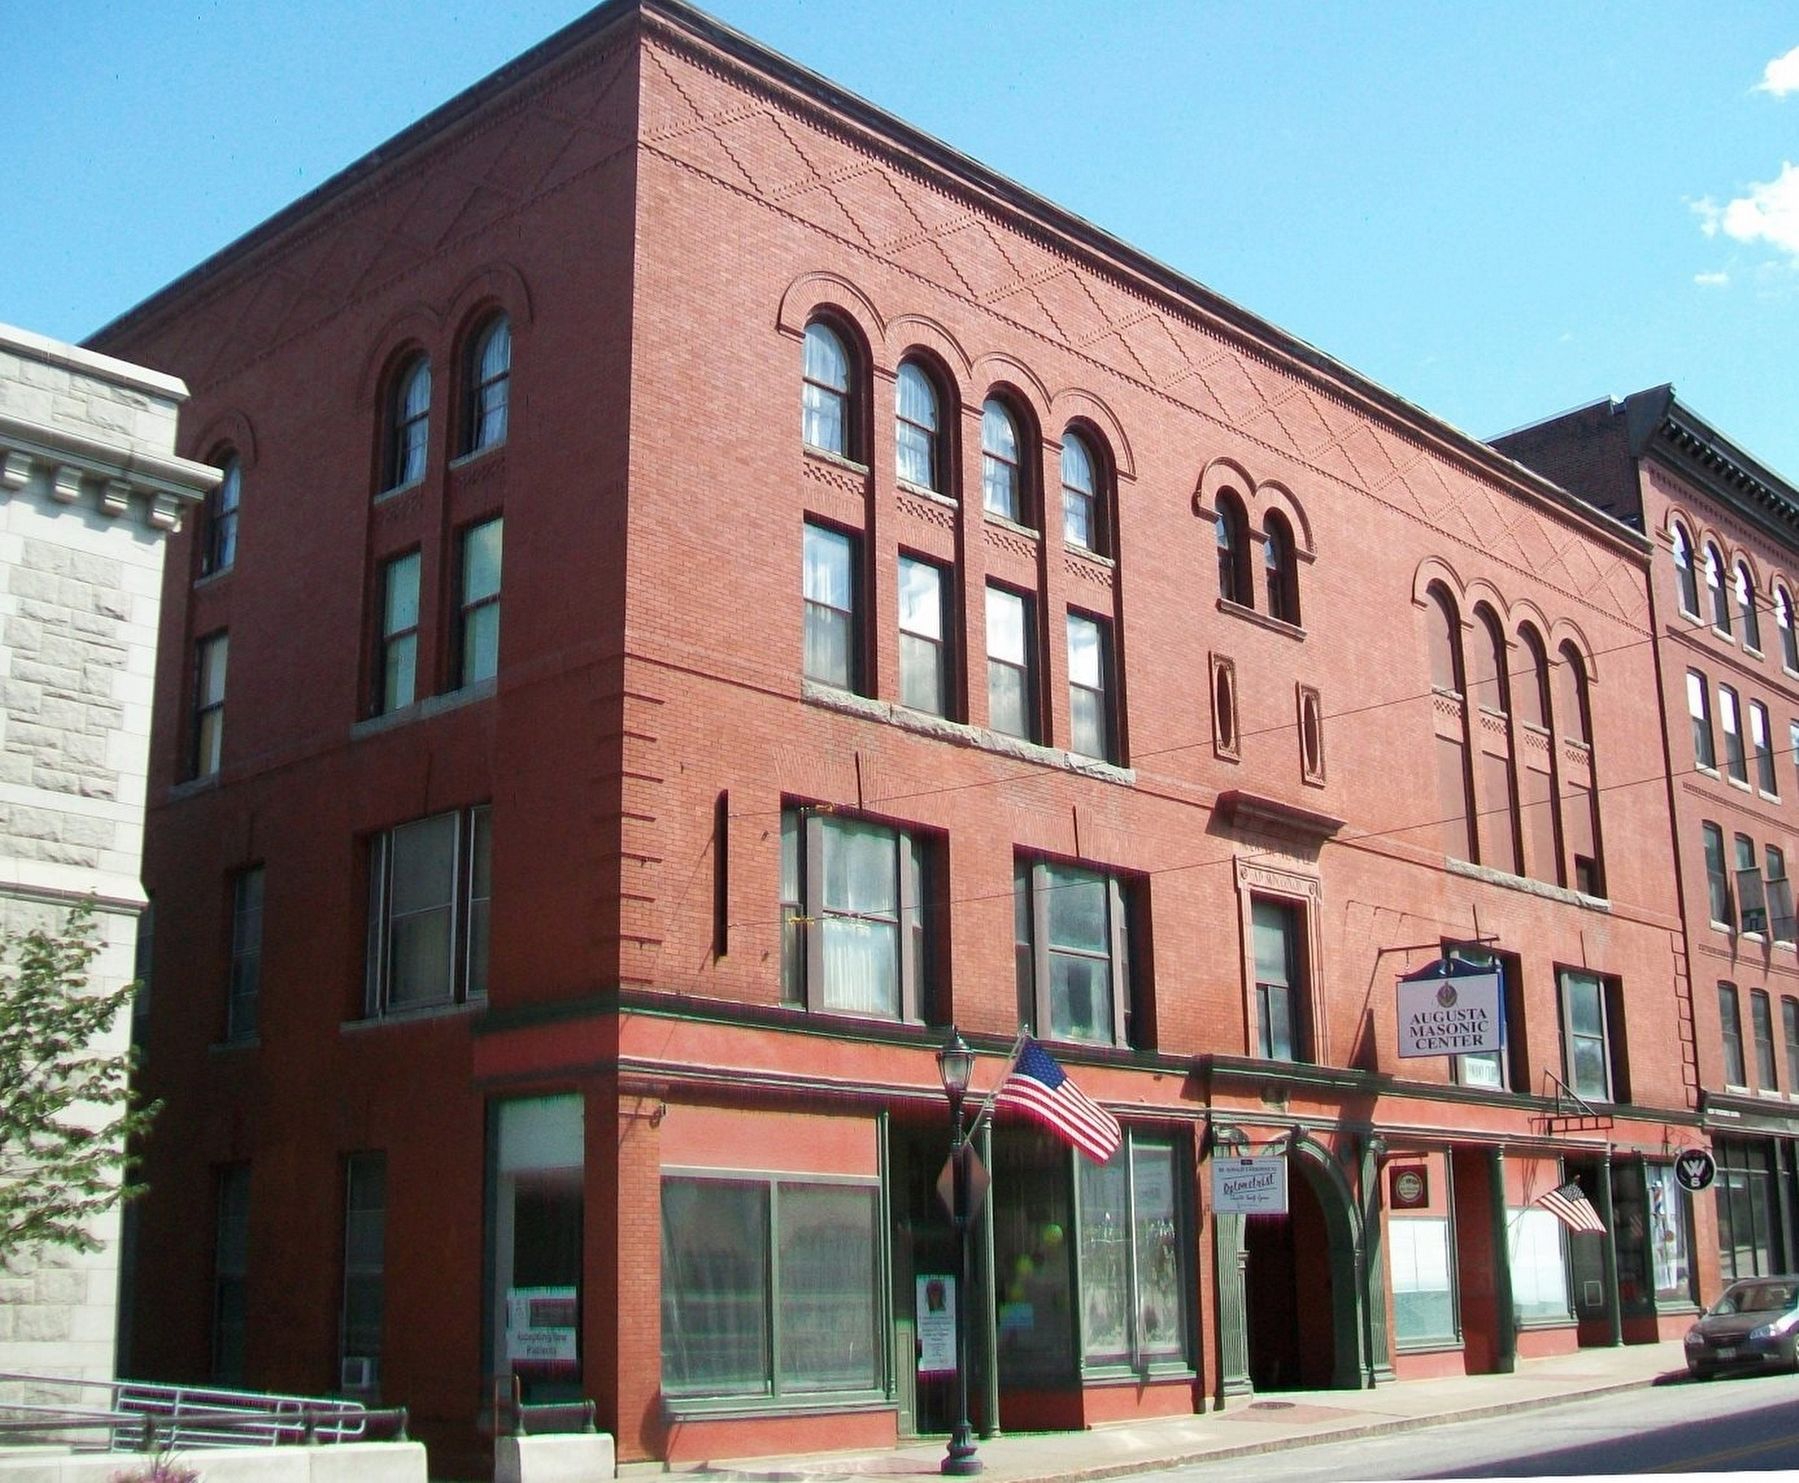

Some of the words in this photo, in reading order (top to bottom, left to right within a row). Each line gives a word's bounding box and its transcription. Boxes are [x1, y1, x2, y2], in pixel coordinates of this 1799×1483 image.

[1410, 1008, 1487, 1025] AUGUSTA
[1409, 1020, 1489, 1038] MASONIC
[1415, 1034, 1484, 1050] CENTER
[1223, 1174, 1274, 1194] Optometrist
